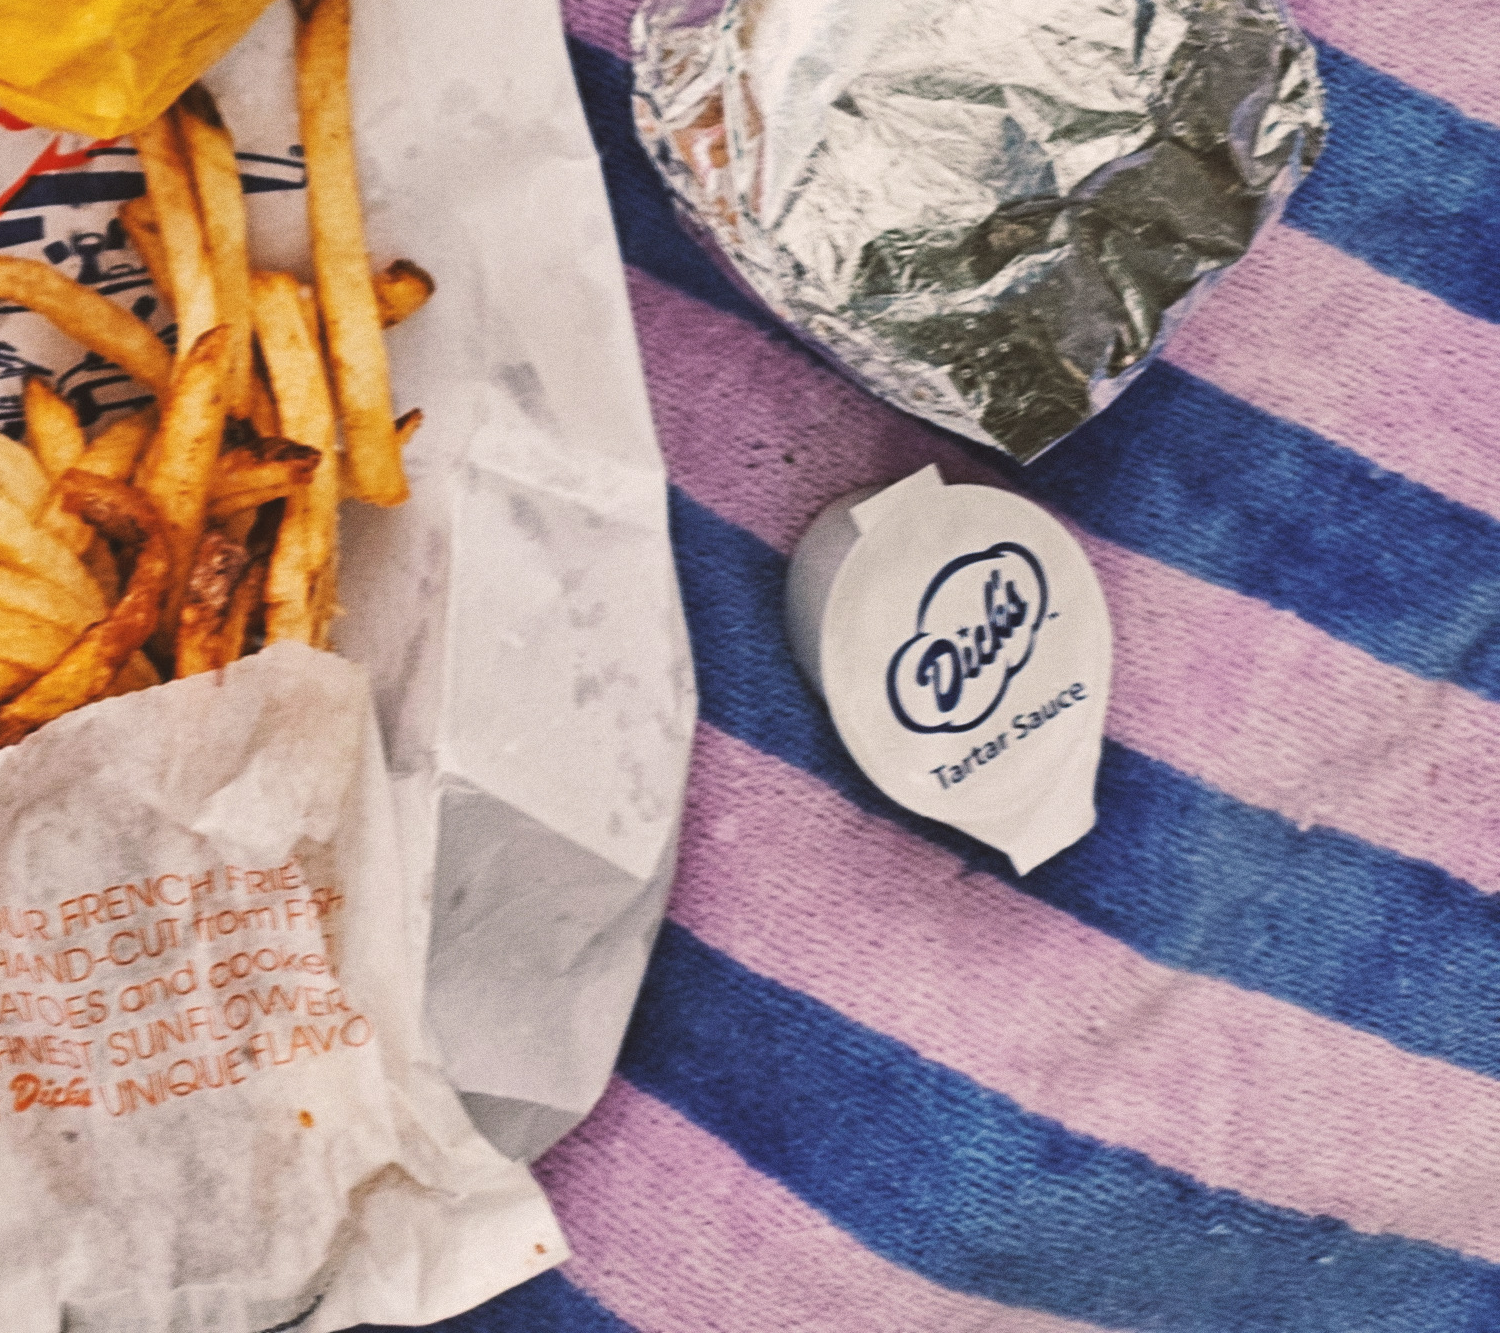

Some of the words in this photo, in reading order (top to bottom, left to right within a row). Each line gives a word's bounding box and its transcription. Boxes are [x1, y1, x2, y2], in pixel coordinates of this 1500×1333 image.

[916, 569, 1029, 714] Dick's
[929, 732, 1011, 791] Tartar
[1011, 681, 1089, 740] Sauce
[59, 870, 216, 937] FRENCH
[224, 857, 301, 895] FRIE
[193, 906, 278, 944] from
[119, 959, 198, 1013] and
[209, 945, 328, 990] cooke
[99, 1046, 247, 1118] UNIQUE
[248, 1014, 374, 1074] FLAVO
[107, 984, 353, 1067] SUNFLOWER
